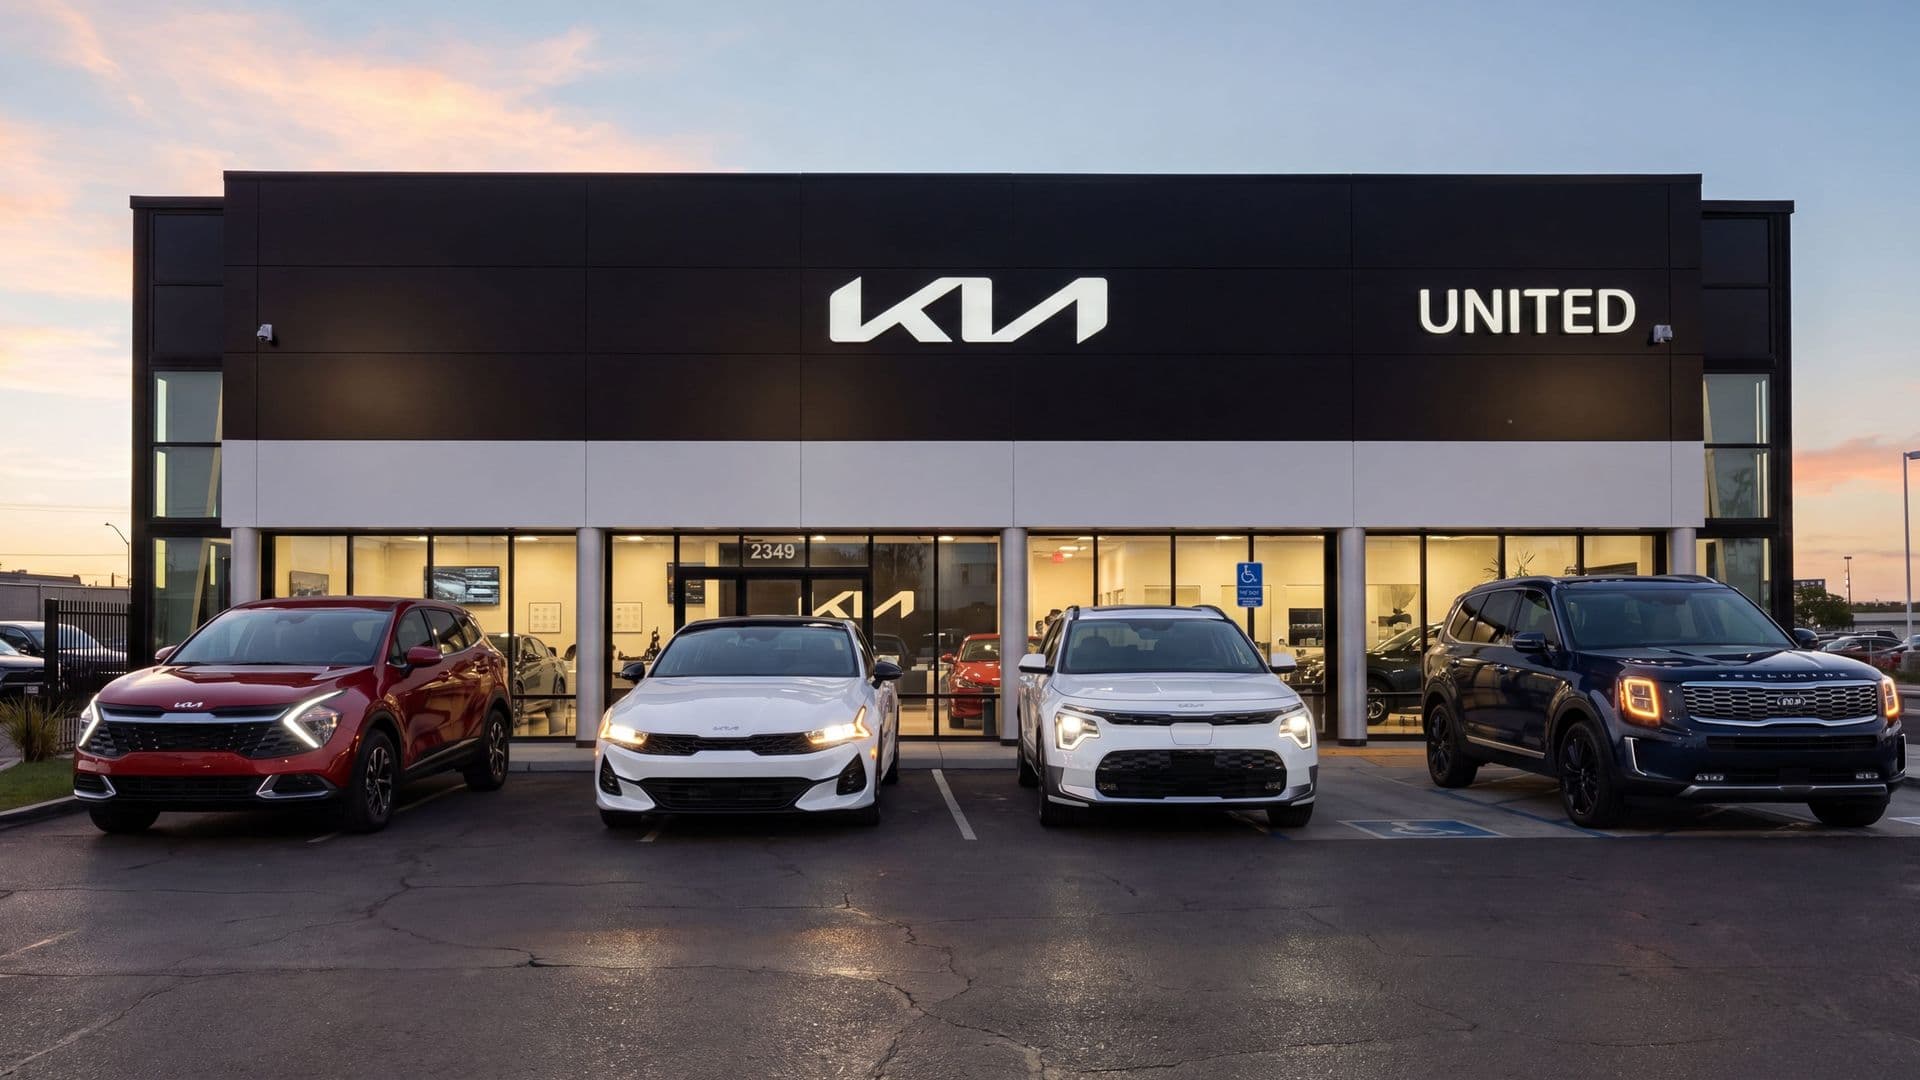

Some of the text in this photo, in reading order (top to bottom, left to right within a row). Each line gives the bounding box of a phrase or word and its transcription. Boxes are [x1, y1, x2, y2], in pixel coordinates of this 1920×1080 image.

[830, 276, 1108, 344] KIA
[1419, 289, 1636, 333] UNITED
[751, 543, 795, 559] 2349
